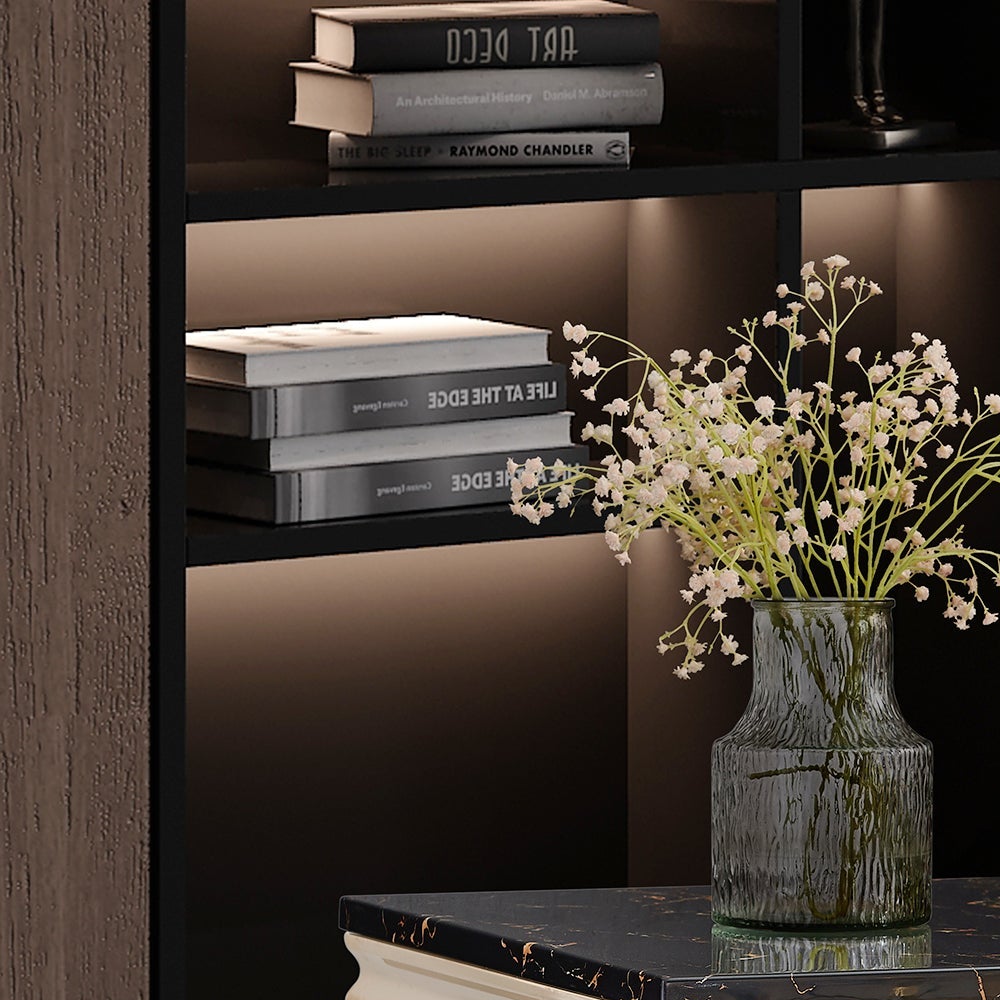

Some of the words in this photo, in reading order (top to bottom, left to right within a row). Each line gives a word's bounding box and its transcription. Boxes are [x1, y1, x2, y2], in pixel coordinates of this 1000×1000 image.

[395, 96, 412, 108] An
[414, 92, 490, 106] Architectural
[491, 91, 533, 106] History
[543, 90, 577, 101] Daniel
[593, 87, 648, 99] Abramson
[337, 147, 361, 158] THE
[395, 146, 432, 158] SLEEP
[449, 145, 519, 157] RAYMOND
[523, 144, 594, 156] CHANDLER
